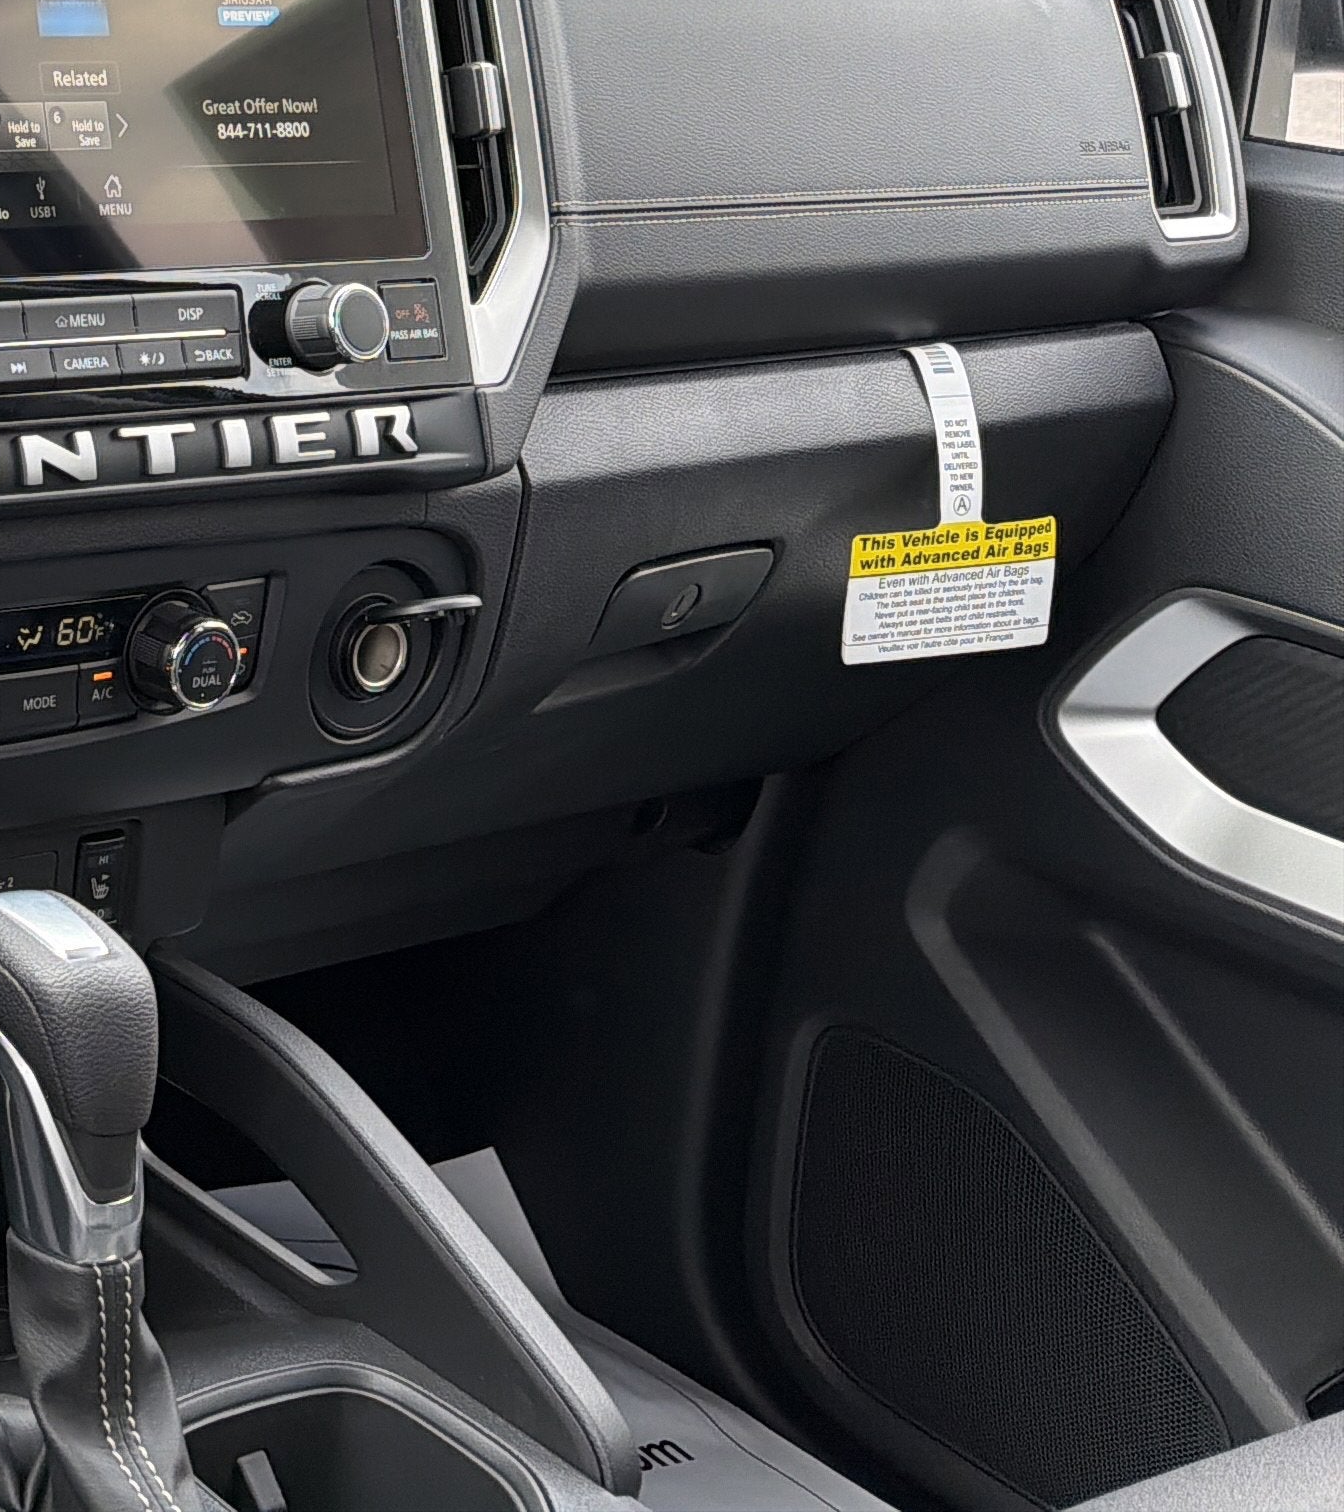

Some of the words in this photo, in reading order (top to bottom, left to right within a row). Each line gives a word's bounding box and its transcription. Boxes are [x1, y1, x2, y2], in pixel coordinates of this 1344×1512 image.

[222, 10, 272, 23] PREVIEW
[52, 71, 108, 87] Related
[202, 99, 241, 116] Great
[243, 99, 279, 114] Offer
[282, 98, 318, 113] Now!
[53, 111, 62, 124] 6
[7, 120, 29, 134] Hold
[30, 121, 41, 134] to
[71, 119, 93, 133] Hold
[94, 120, 104, 133] to
[217, 122, 310, 140] 844-711-8800
[14, 136, 37, 148] Save
[78, 134, 101, 147] Save
[29, 206, 57, 219] USB1
[99, 203, 132, 216] MENU
[69, 313, 106, 328] MENU
[178, 307, 204, 322] DISP
[395, 309, 411, 320] OFF
[390, 329, 409, 340] PASS
[410, 328, 422, 339] AIR
[423, 328, 439, 339] BAG
[206, 348, 234, 363] BACK
[64, 355, 109, 371] CAMERA
[268, 357, 293, 368] ENTER
[944, 419, 954, 428] DO
[955, 419, 968, 428] NOT
[944, 429, 972, 439] REMOVE
[942, 441, 956, 450] THIS
[957, 440, 976, 449] LABEL
[951, 451, 970, 460] UNTIL
[944, 462, 979, 471] DELIVERED
[949, 473, 959, 482] TO
[960, 472, 974, 481] NEW
[859, 536, 896, 551] This
[902, 530, 960, 548] Vehicle
[965, 528, 979, 542] is
[984, 519, 1052, 542] Equipped
[860, 554, 896, 570] with
[900, 546, 981, 566] Advanced
[984, 544, 1009, 559] Air
[1013, 541, 1050, 557] Bags
[878, 577, 905, 589] Even
[908, 574, 930, 587] with
[931, 569, 984, 584] Advanced
[986, 567, 1001, 579] Air
[1003, 565, 1030, 579] Bags
[57, 616, 105, 647] 60°F
[192, 676, 222, 689] DUAL
[92, 688, 113, 702] A/C
[23, 695, 57, 712] MODE
[99, 855, 110, 865] HI
